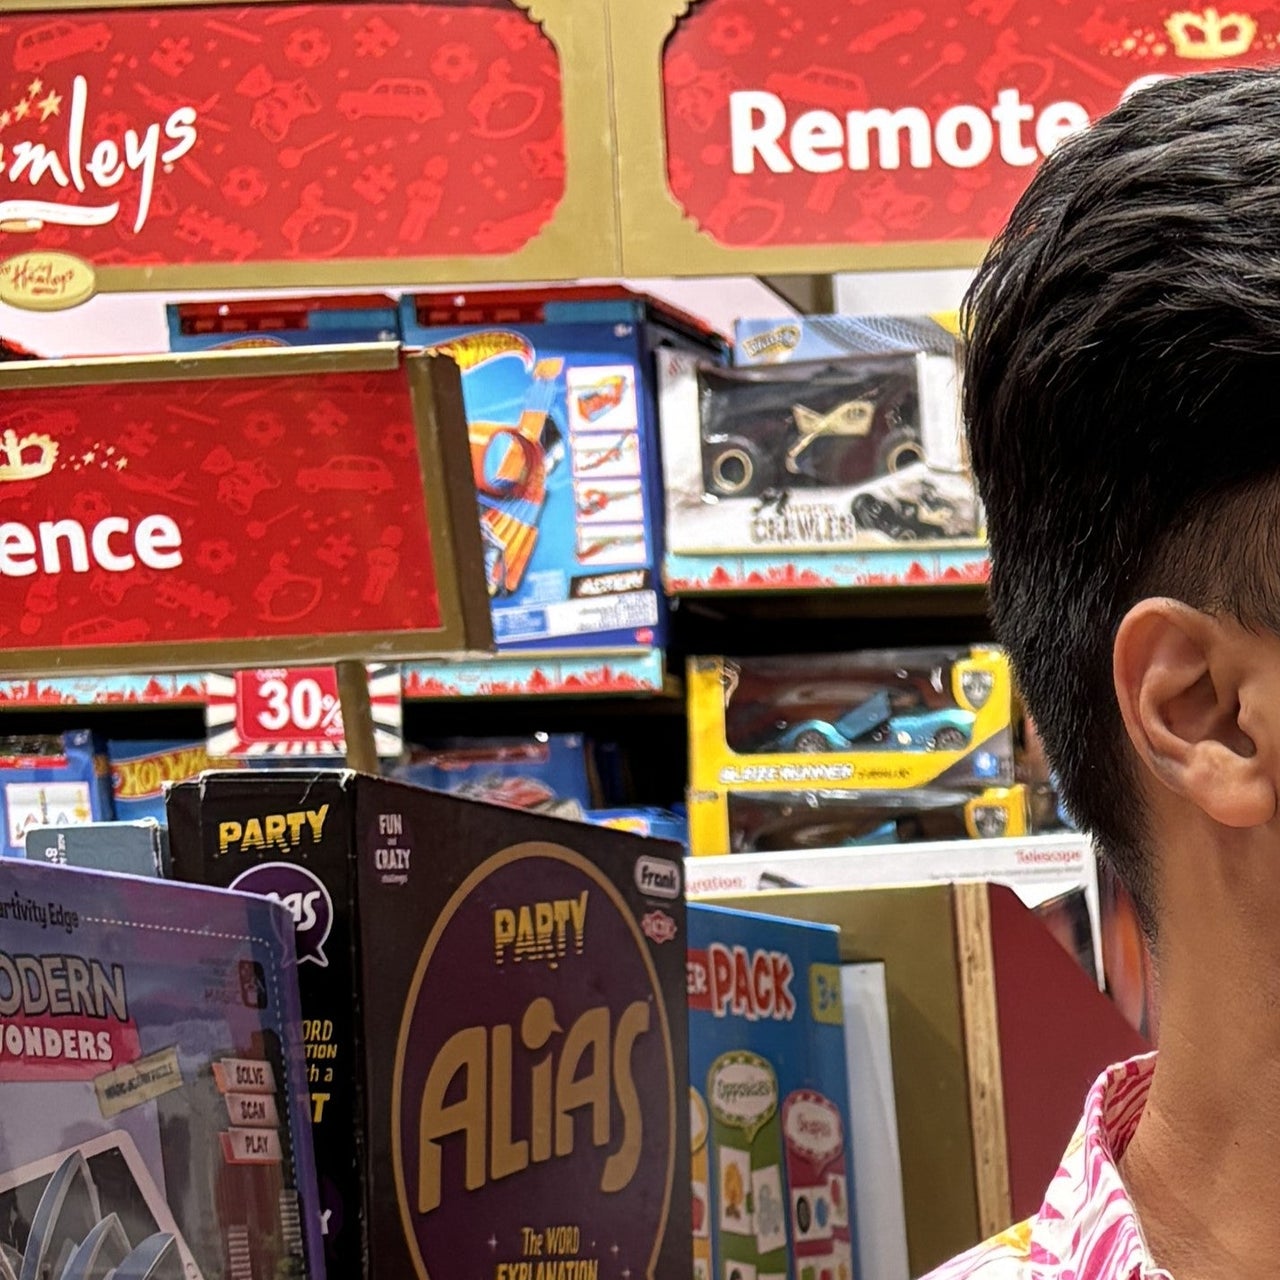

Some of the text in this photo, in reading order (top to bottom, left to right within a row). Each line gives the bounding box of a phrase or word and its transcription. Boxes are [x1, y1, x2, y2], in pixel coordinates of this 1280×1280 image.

[729, 87, 1088, 174] Remote
[0, 75, 197, 233] mleys
[256, 677, 343, 731] 30%
[217, 803, 331, 855] PARTY
[378, 813, 403, 836] FUN
[375, 848, 412, 872] CRAZY
[48, 902, 80, 934] Edge
[493, 889, 589, 969] PARTY
[708, 941, 797, 1020] PACK
[0, 1023, 114, 1062] ONDERS
[235, 1065, 266, 1086] SOLVE
[240, 1101, 266, 1120] SCAN
[244, 1135, 270, 1155] PLAY
[521, 1226, 581, 1256] The WORD
